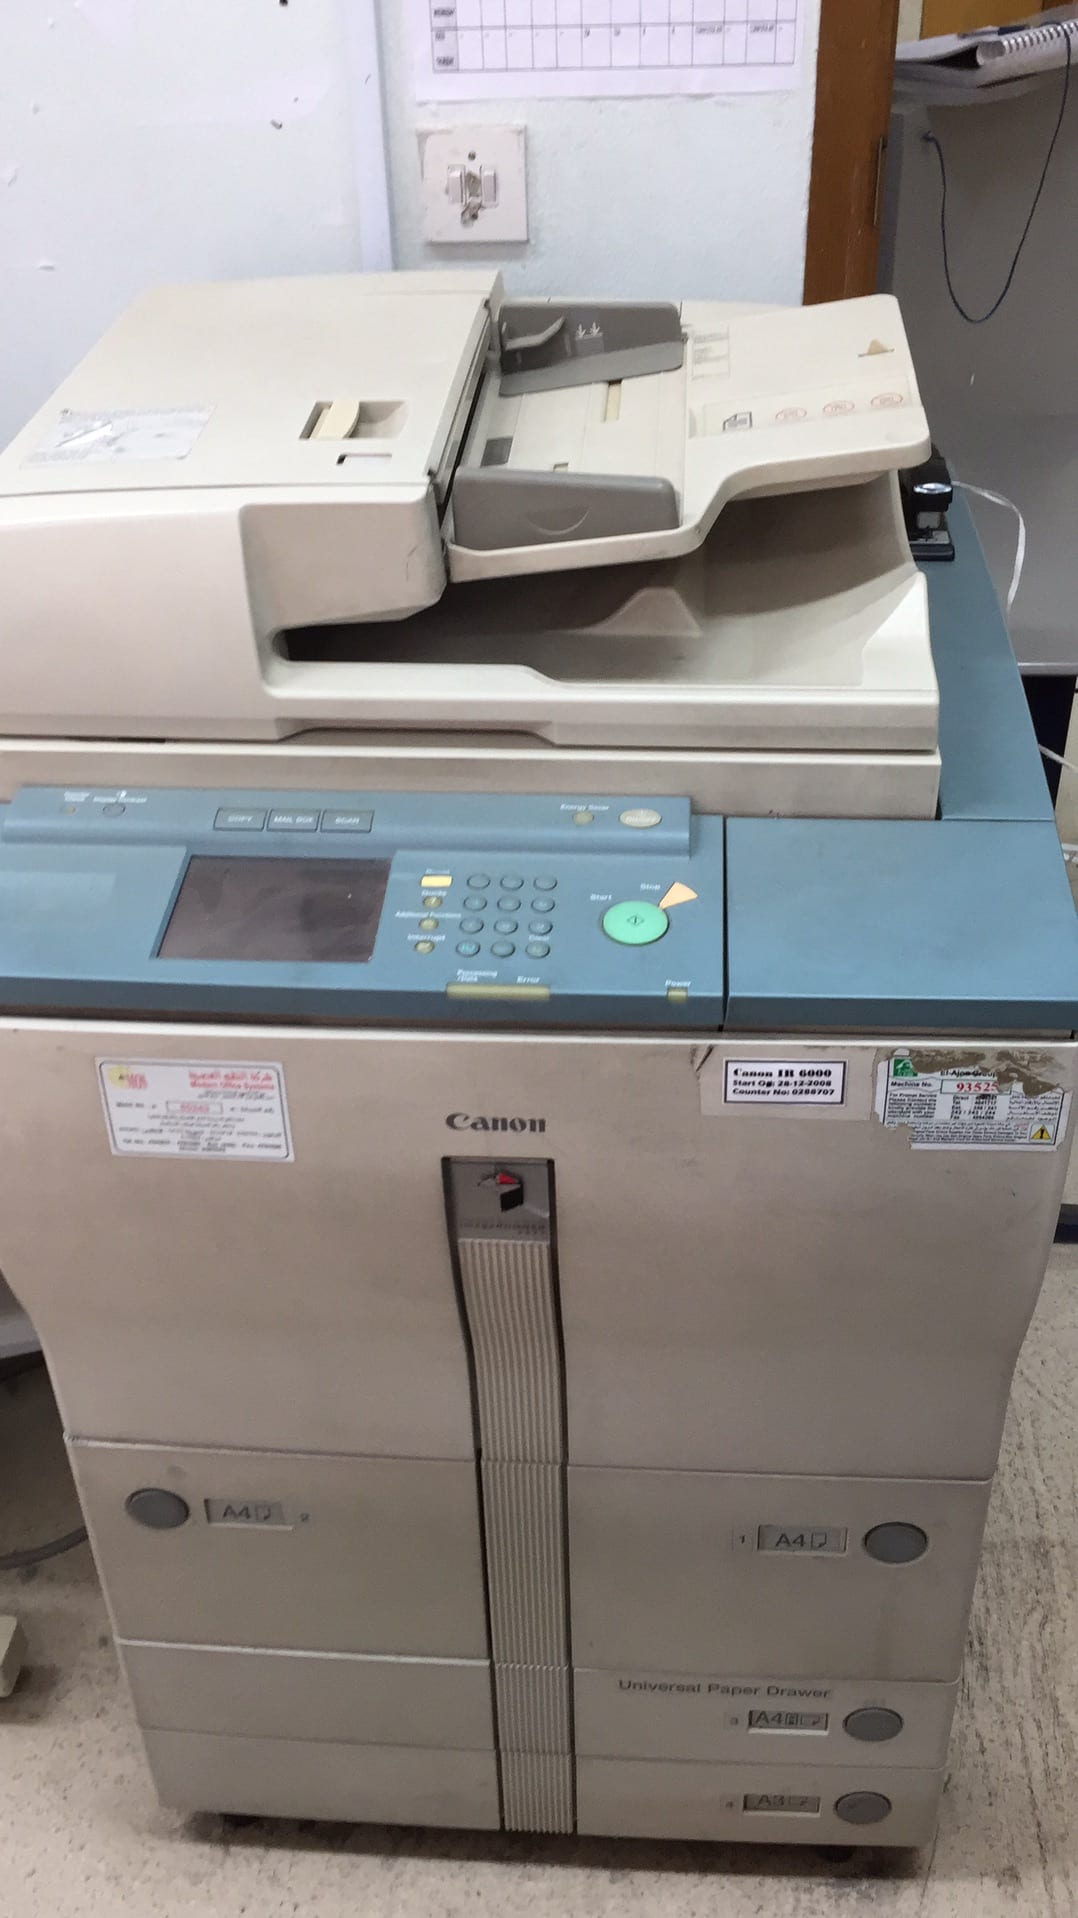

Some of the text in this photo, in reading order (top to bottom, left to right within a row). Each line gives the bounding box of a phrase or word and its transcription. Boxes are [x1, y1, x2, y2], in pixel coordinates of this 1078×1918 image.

[640, 883, 661, 891] Stop
[516, 975, 541, 984] Error
[665, 979, 692, 987] Power
[733, 1068, 773, 1078] Canon
[799, 1069, 832, 1078] 6000
[732, 1088, 771, 1096] Counter
[773, 1088, 790, 1096] No:
[445, 1112, 547, 1133] Canon
[223, 1505, 251, 1519] A4
[775, 1533, 805, 1547] A4
[618, 1679, 831, 1698] Universal Paper Drawer
[755, 1711, 783, 1725] A4
